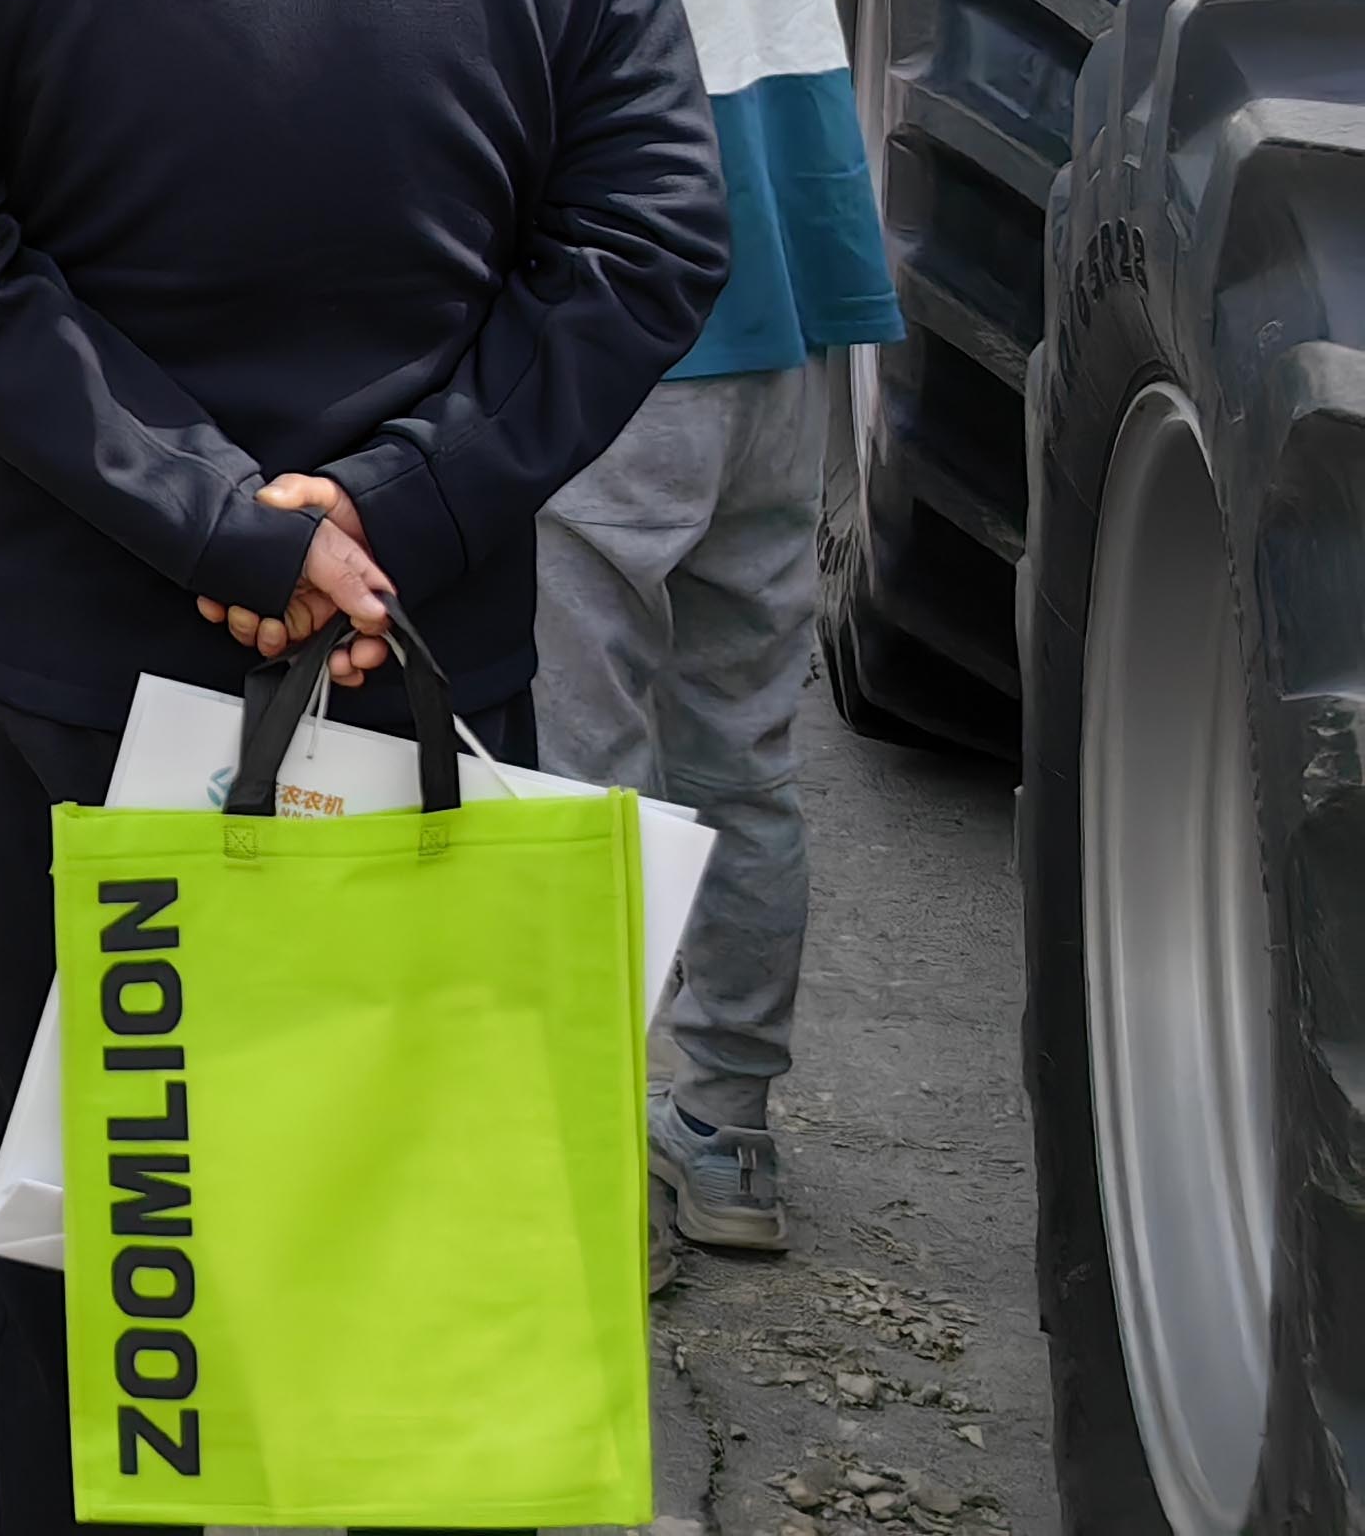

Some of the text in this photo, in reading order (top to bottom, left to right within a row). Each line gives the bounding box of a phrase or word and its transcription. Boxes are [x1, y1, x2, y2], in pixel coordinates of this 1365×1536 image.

[277, 783, 344, 816] 农农机
[97, 877, 201, 1476] ZOOMLION
